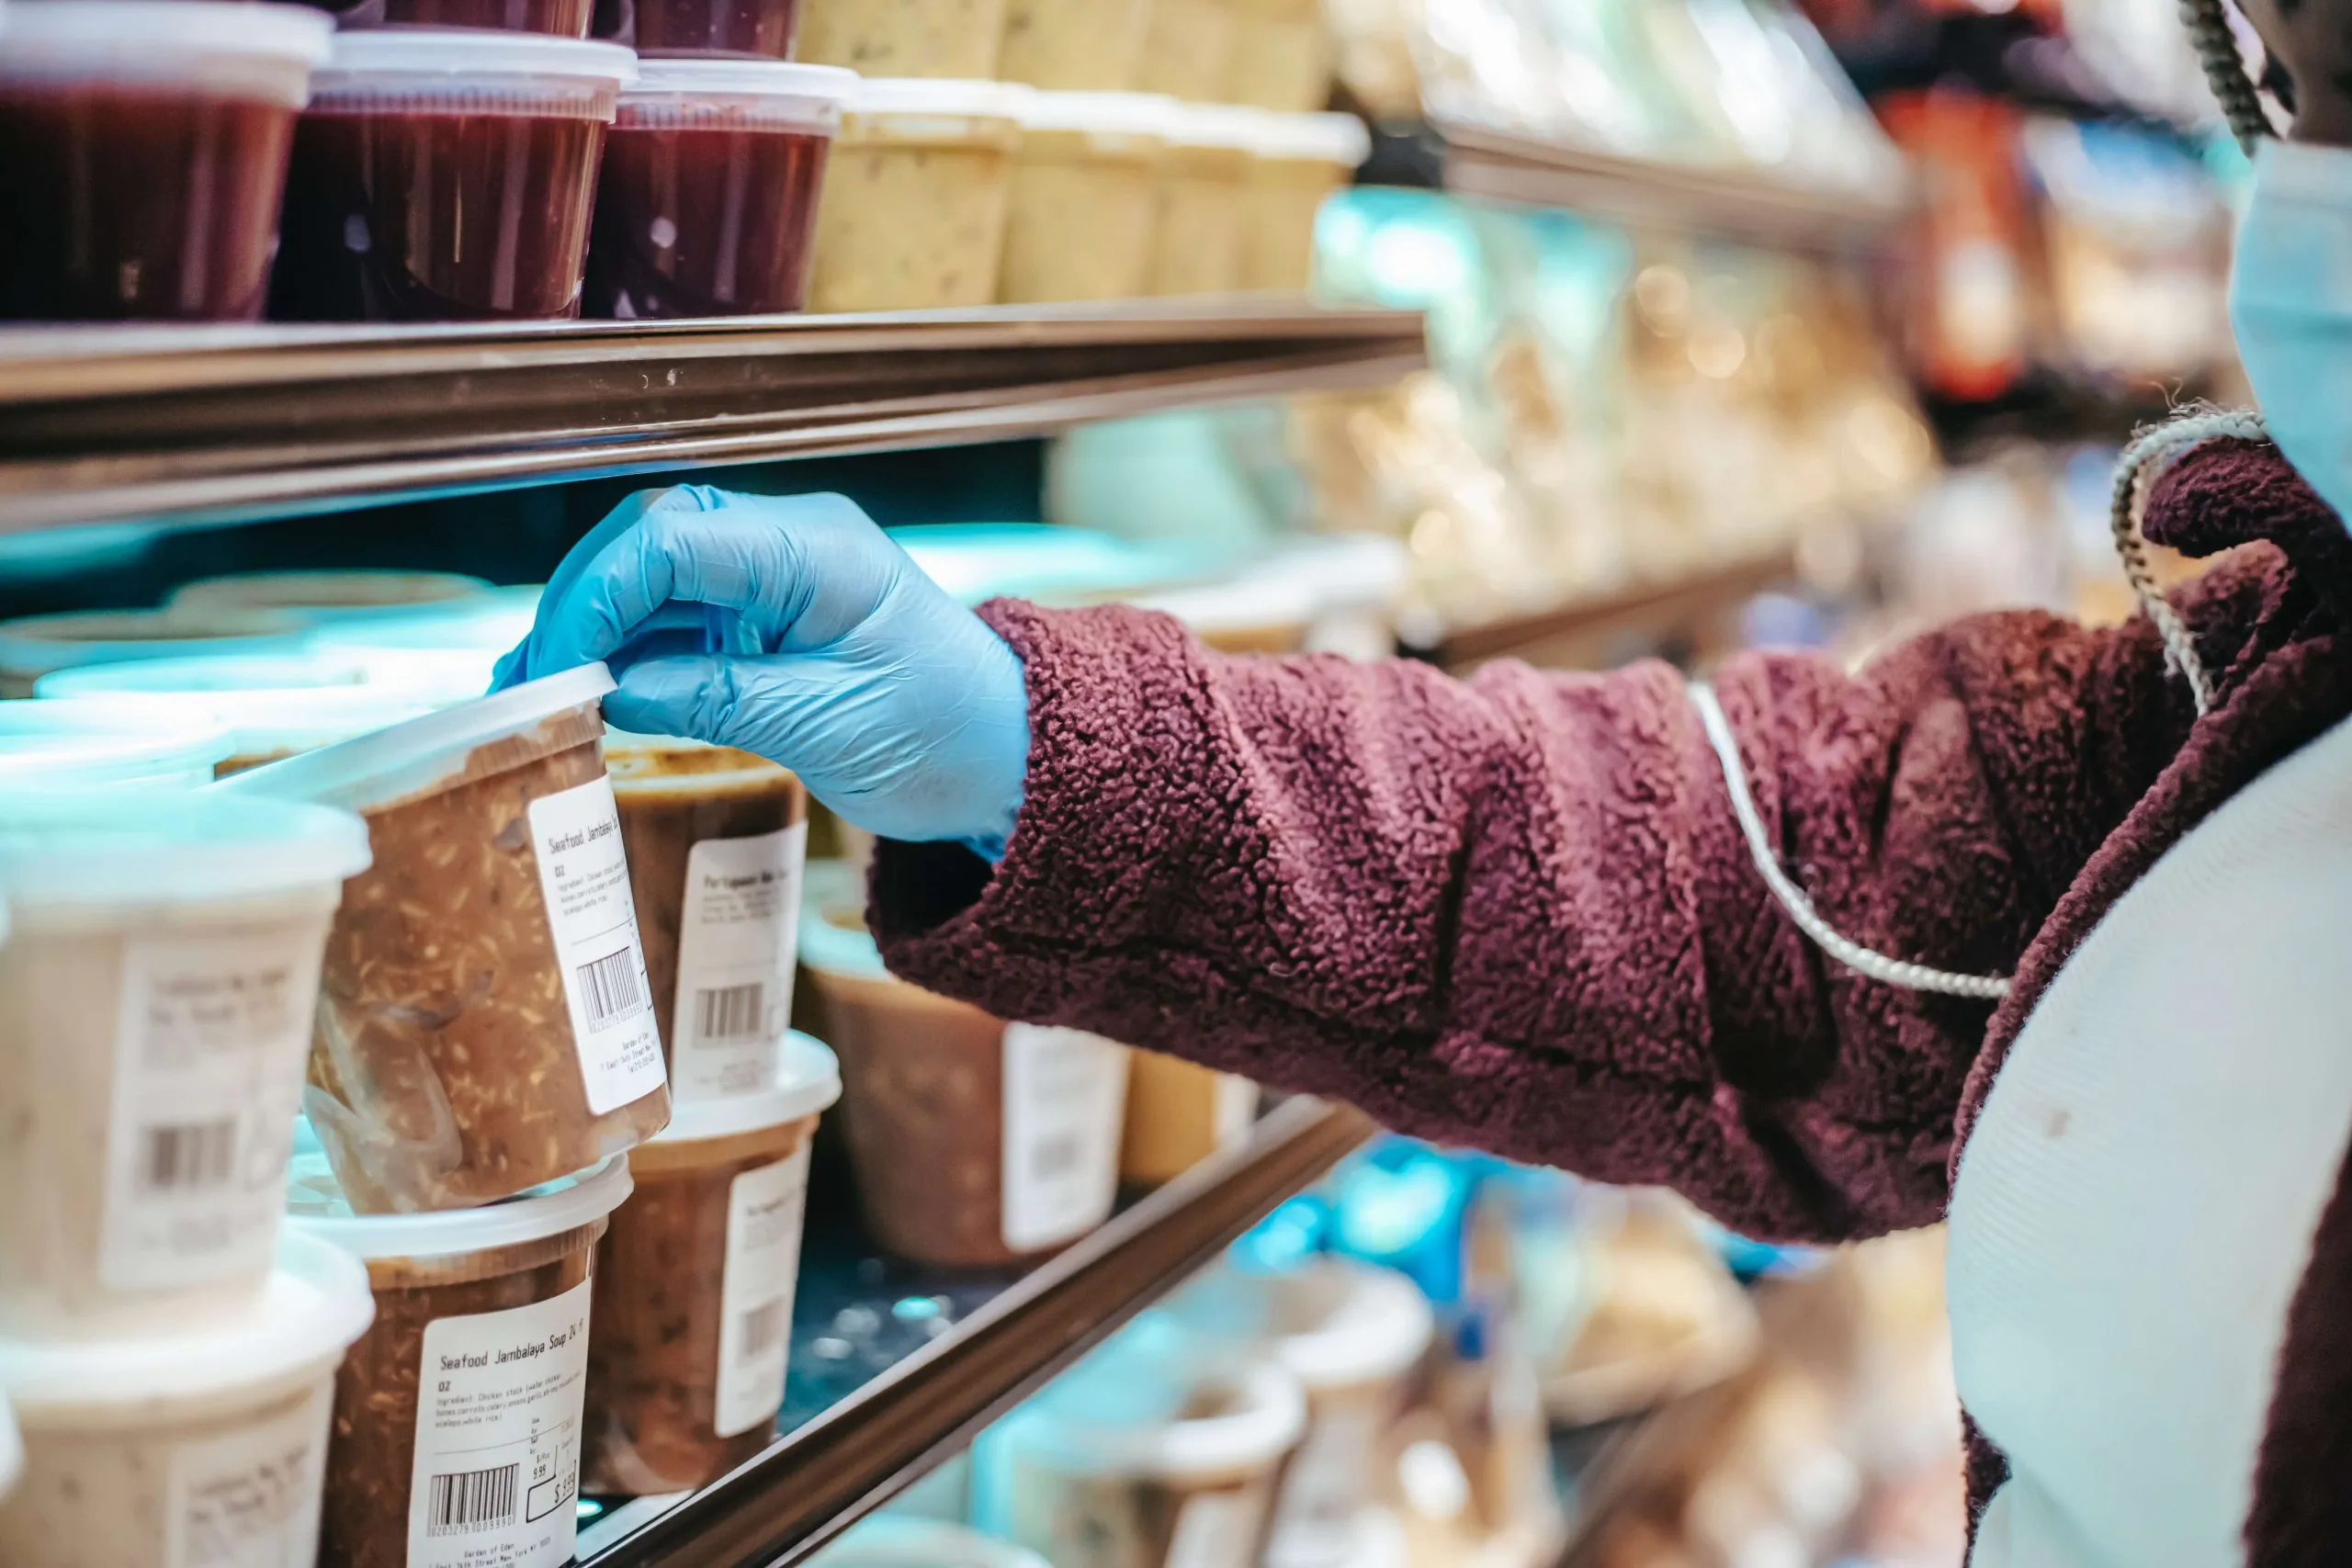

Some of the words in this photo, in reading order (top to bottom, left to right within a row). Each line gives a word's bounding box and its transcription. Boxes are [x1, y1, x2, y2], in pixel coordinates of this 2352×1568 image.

[548, 829, 585, 855] Seafood
[440, 1350, 488, 1371] Seafood
[494, 1342, 546, 1365] Jambalaya
[549, 1332, 567, 1350] Soup
[438, 1381, 451, 1393] OZ
[500, 1542, 514, 1552] Eden
